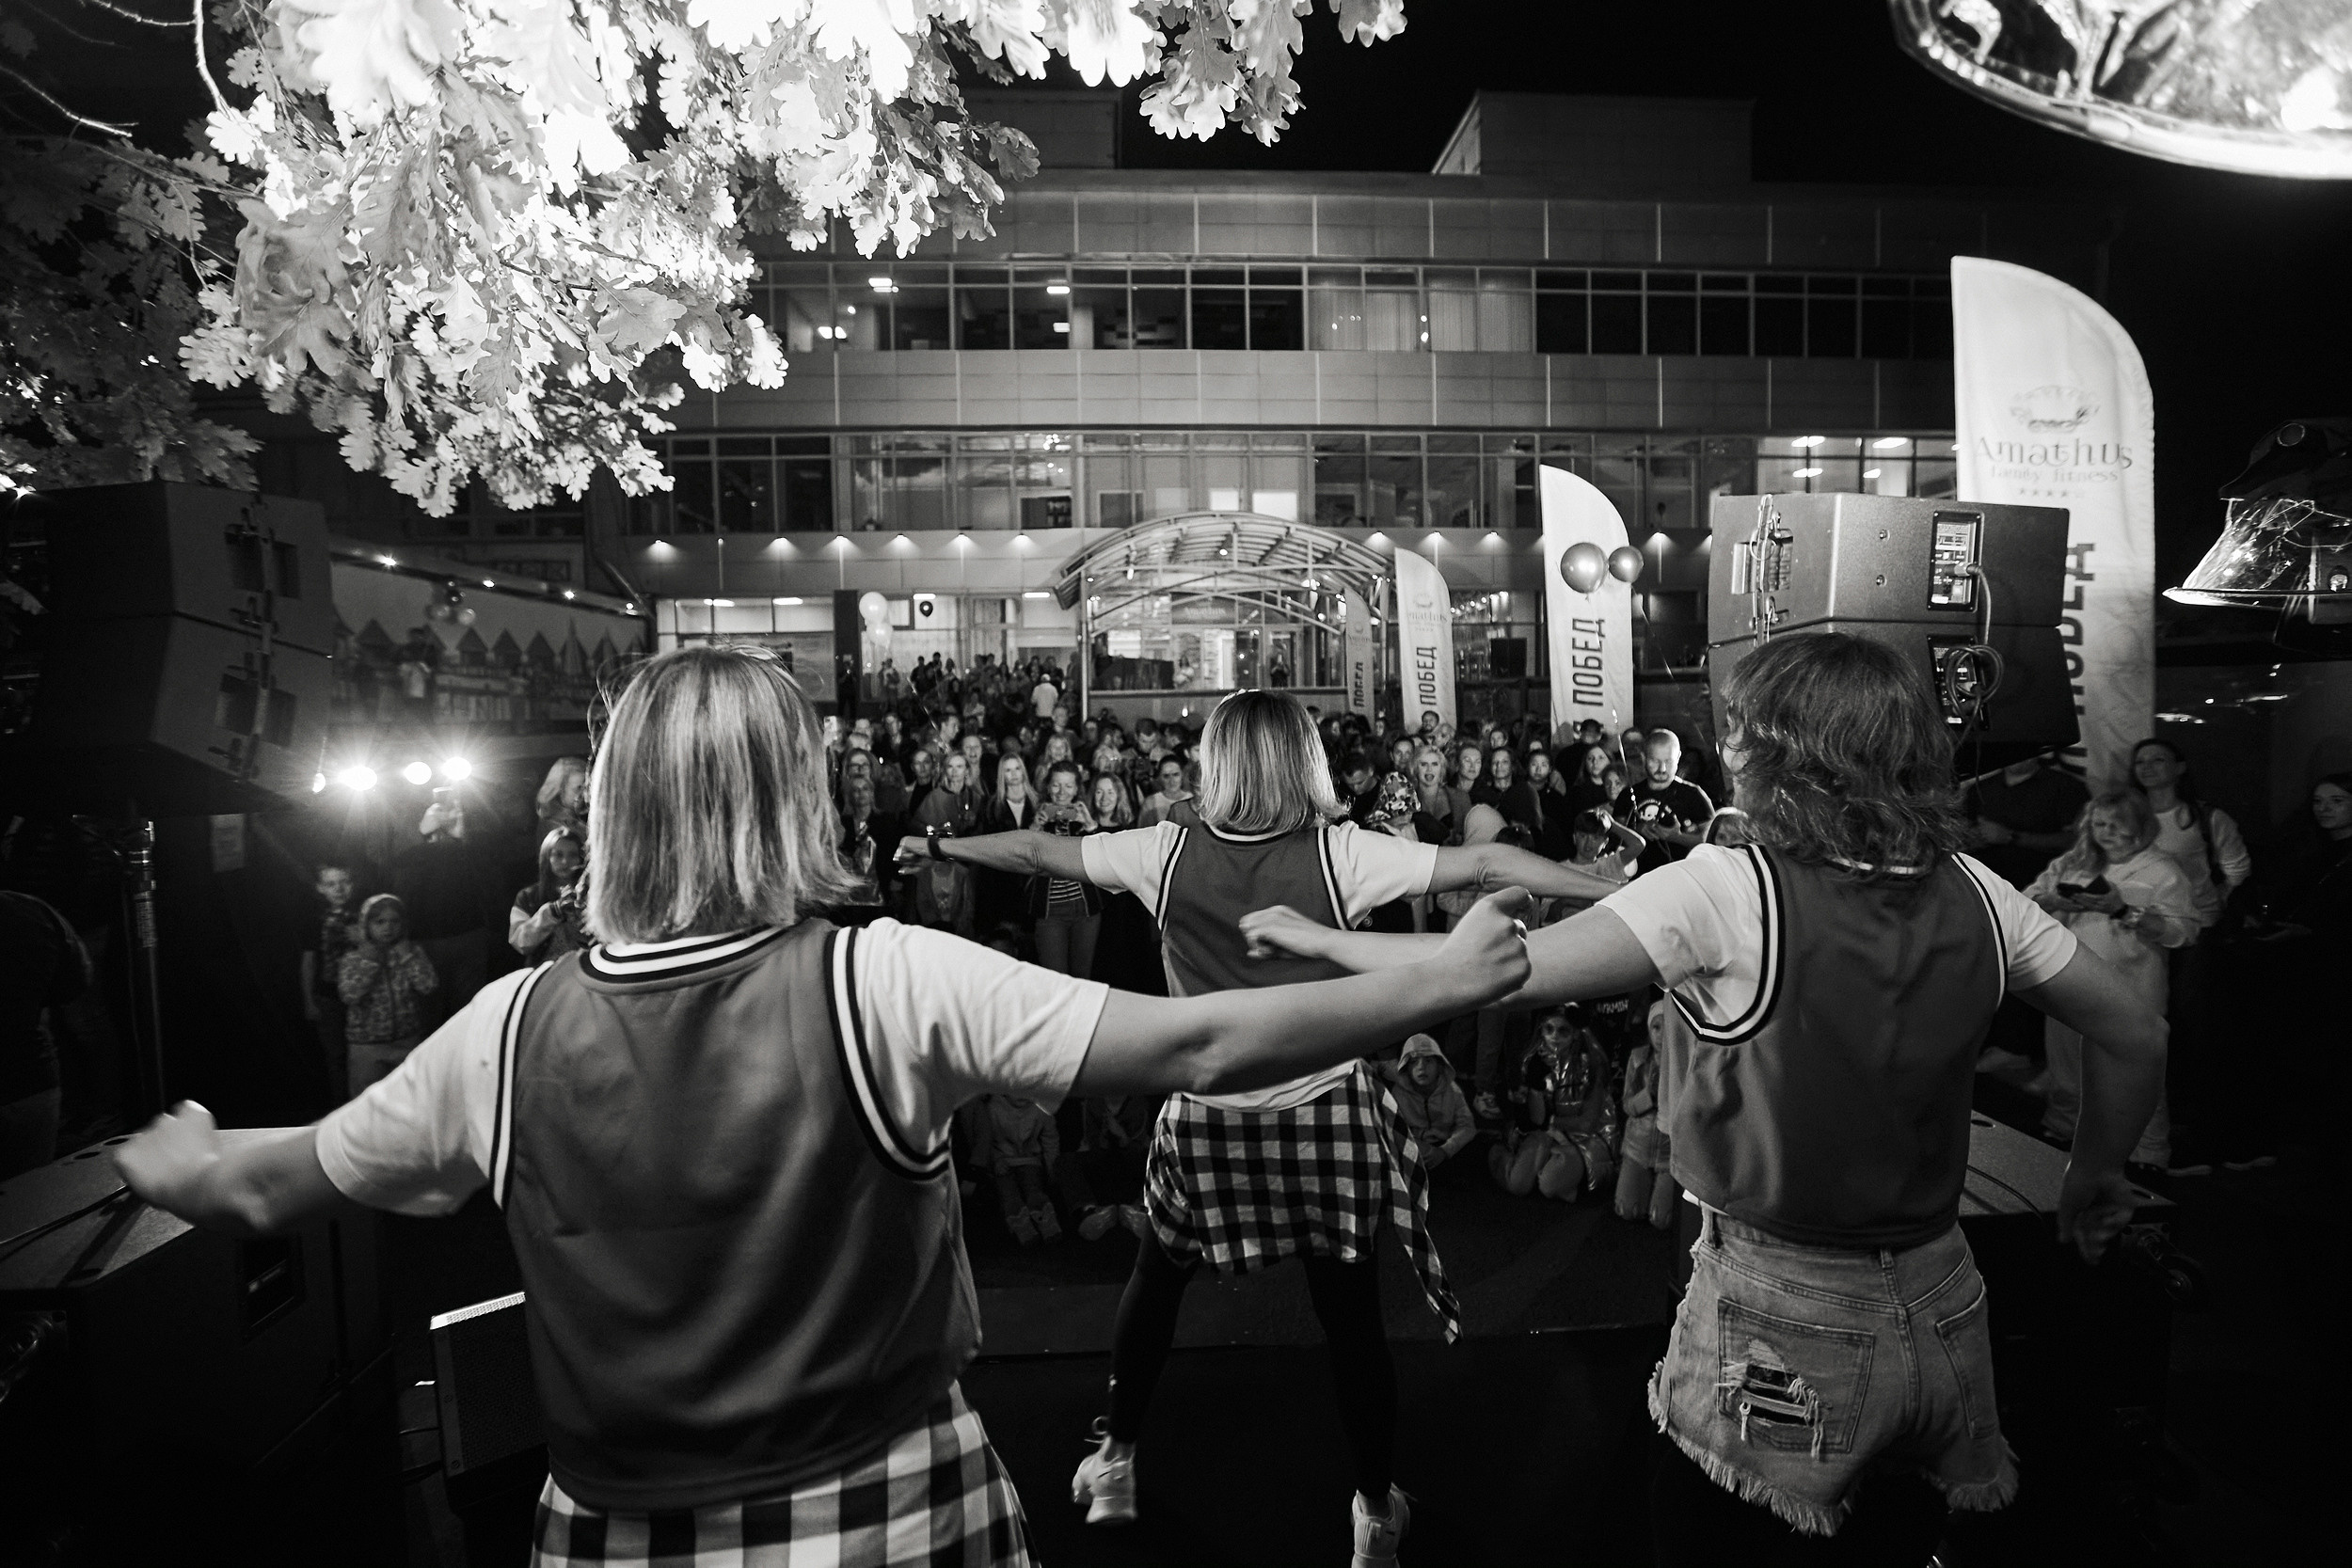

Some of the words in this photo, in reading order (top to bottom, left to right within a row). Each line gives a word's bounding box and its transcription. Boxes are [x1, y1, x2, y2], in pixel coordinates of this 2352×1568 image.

[1978, 436, 2134, 470] Amathus
[1416, 646, 1437, 705] ПОБЕД
[1572, 617, 1605, 707] ПОБЕД
